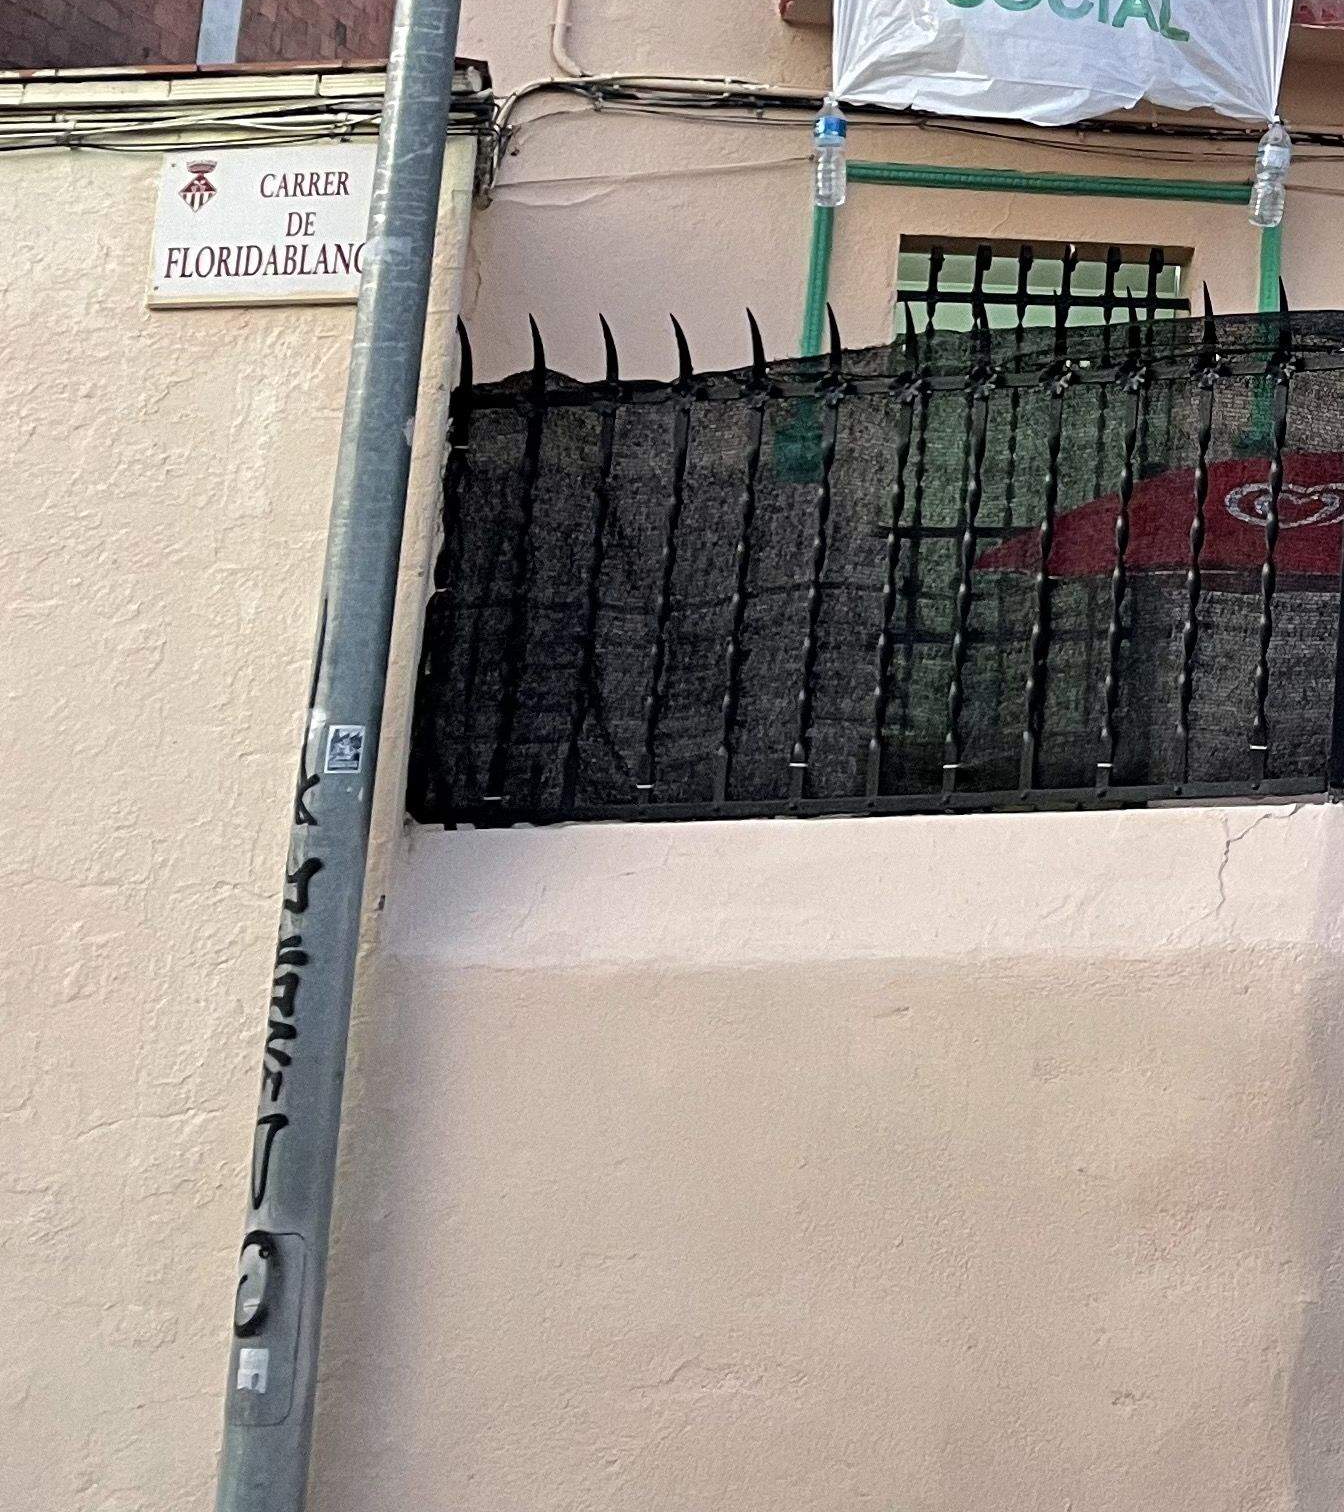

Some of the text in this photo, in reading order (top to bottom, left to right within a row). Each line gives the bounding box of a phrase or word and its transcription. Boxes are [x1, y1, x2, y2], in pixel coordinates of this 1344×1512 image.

[260, 171, 350, 198] CARRER
[286, 211, 316, 237] DE
[164, 242, 366, 279] FLORIDABLANC
